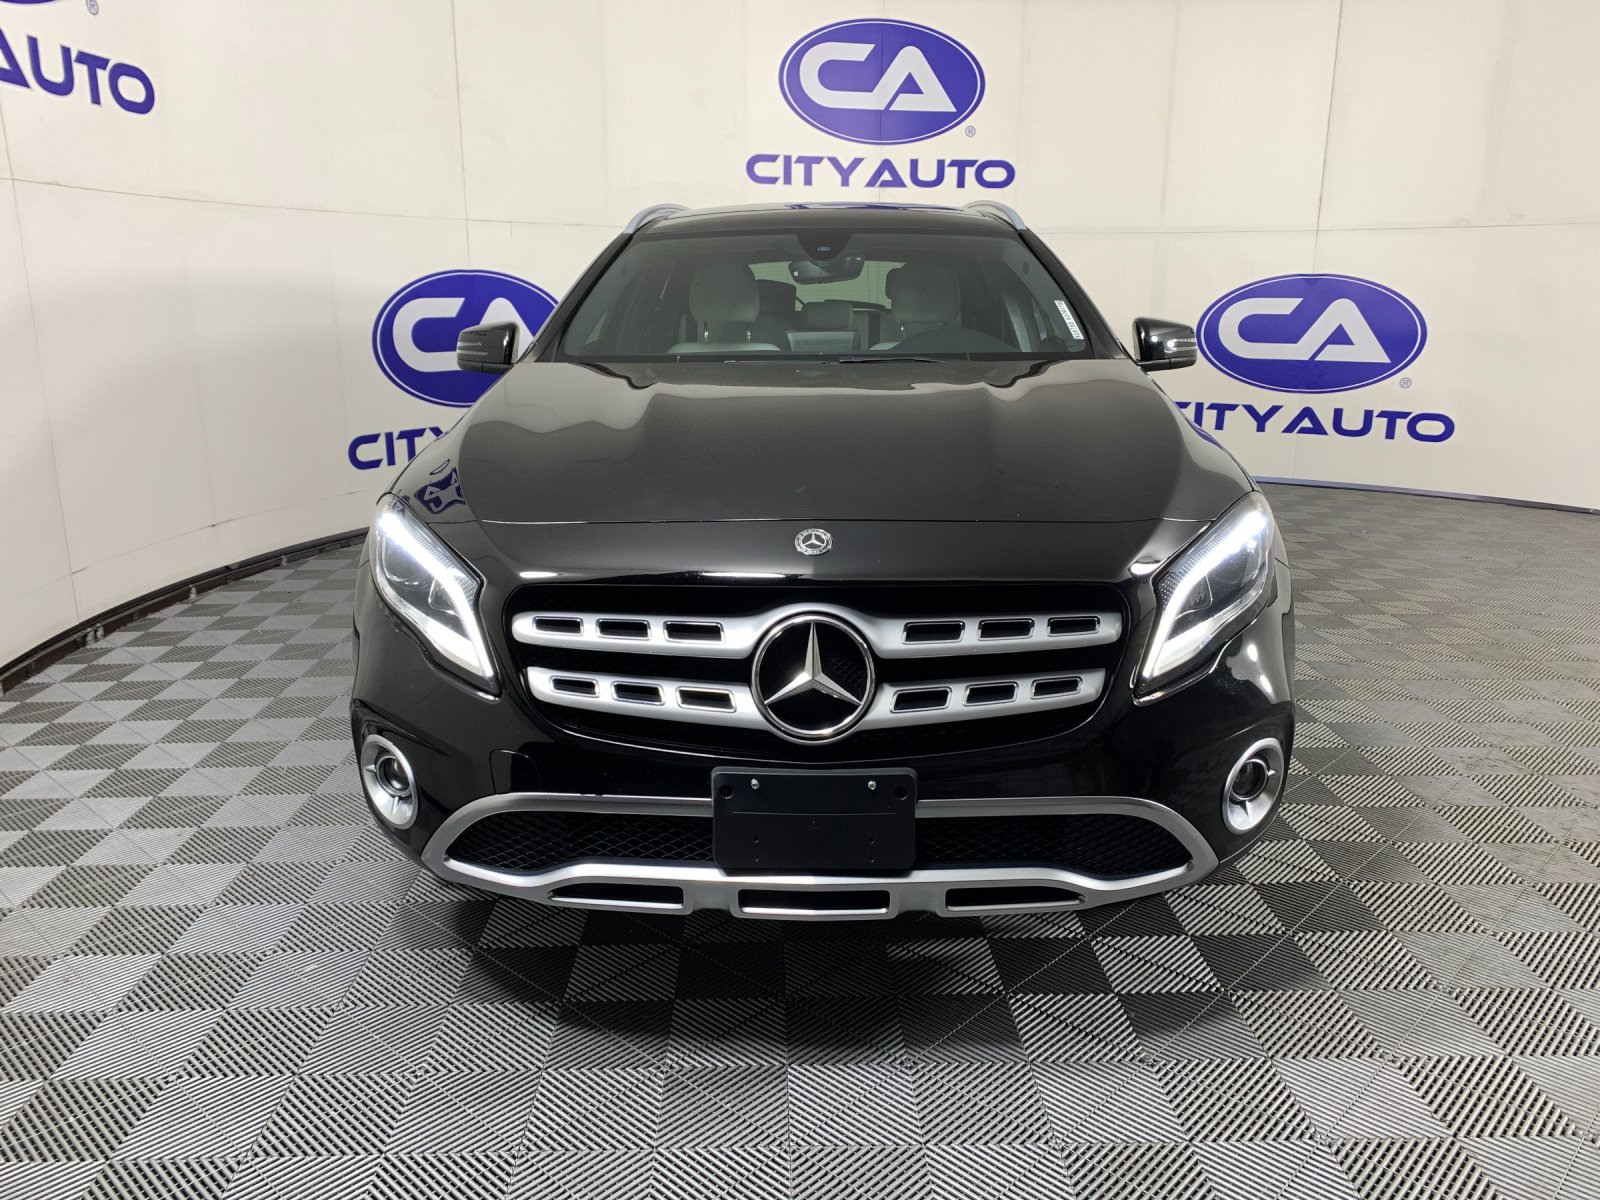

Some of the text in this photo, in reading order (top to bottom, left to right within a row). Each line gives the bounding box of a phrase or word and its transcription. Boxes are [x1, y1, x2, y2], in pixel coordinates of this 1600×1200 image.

[799, 41, 957, 113] CA
[1218, 297, 1391, 364] CA
[347, 426, 443, 471] CIT
